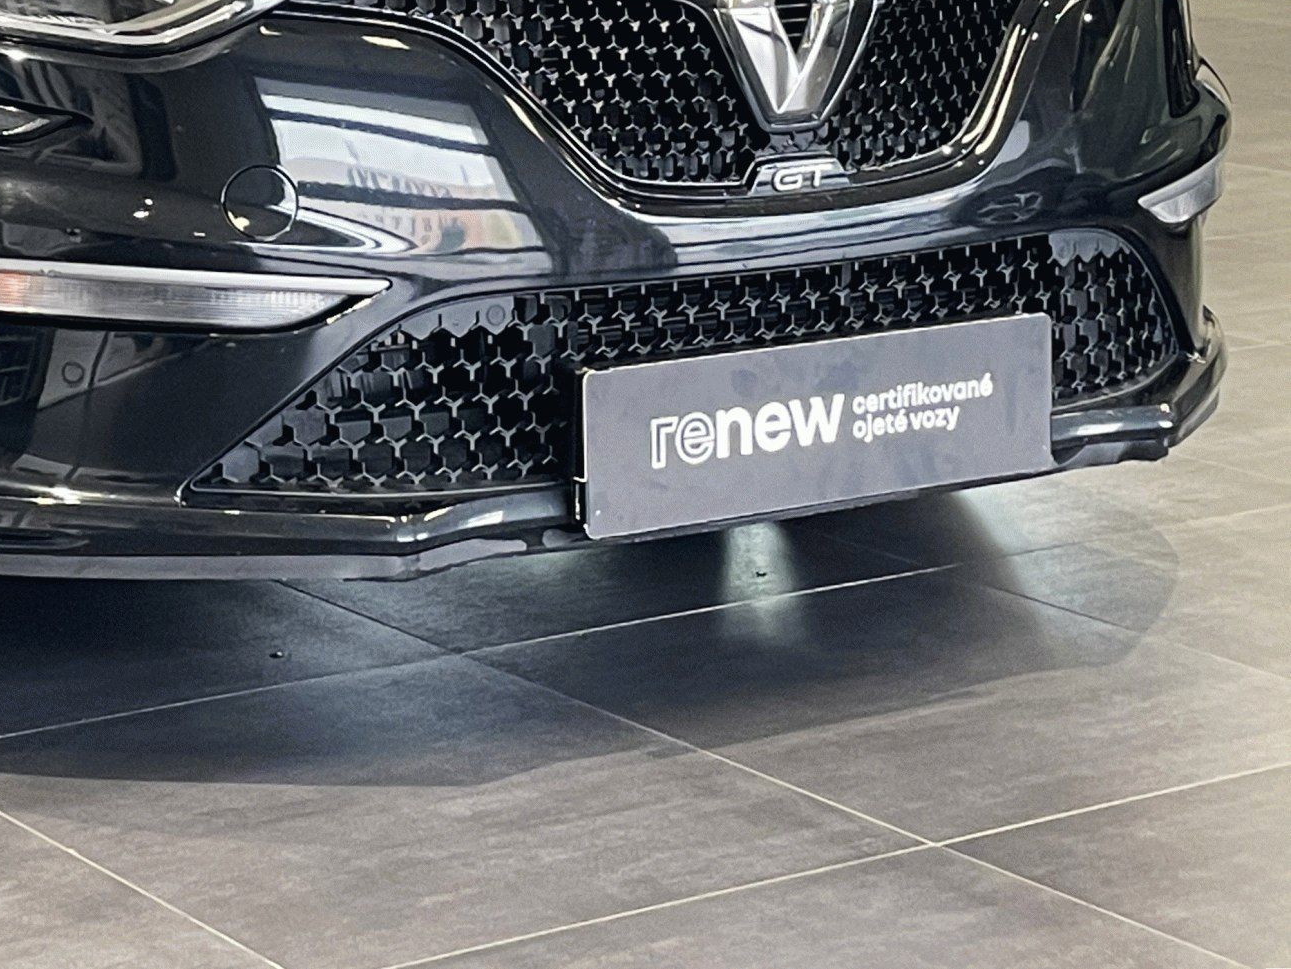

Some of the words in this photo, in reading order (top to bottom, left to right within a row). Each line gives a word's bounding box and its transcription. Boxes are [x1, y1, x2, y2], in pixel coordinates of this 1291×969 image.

[773, 164, 832, 191] GT
[852, 372, 994, 415] certifikované
[650, 393, 845, 470] renew
[852, 408, 909, 443] ojeté
[909, 406, 961, 431] vozy
